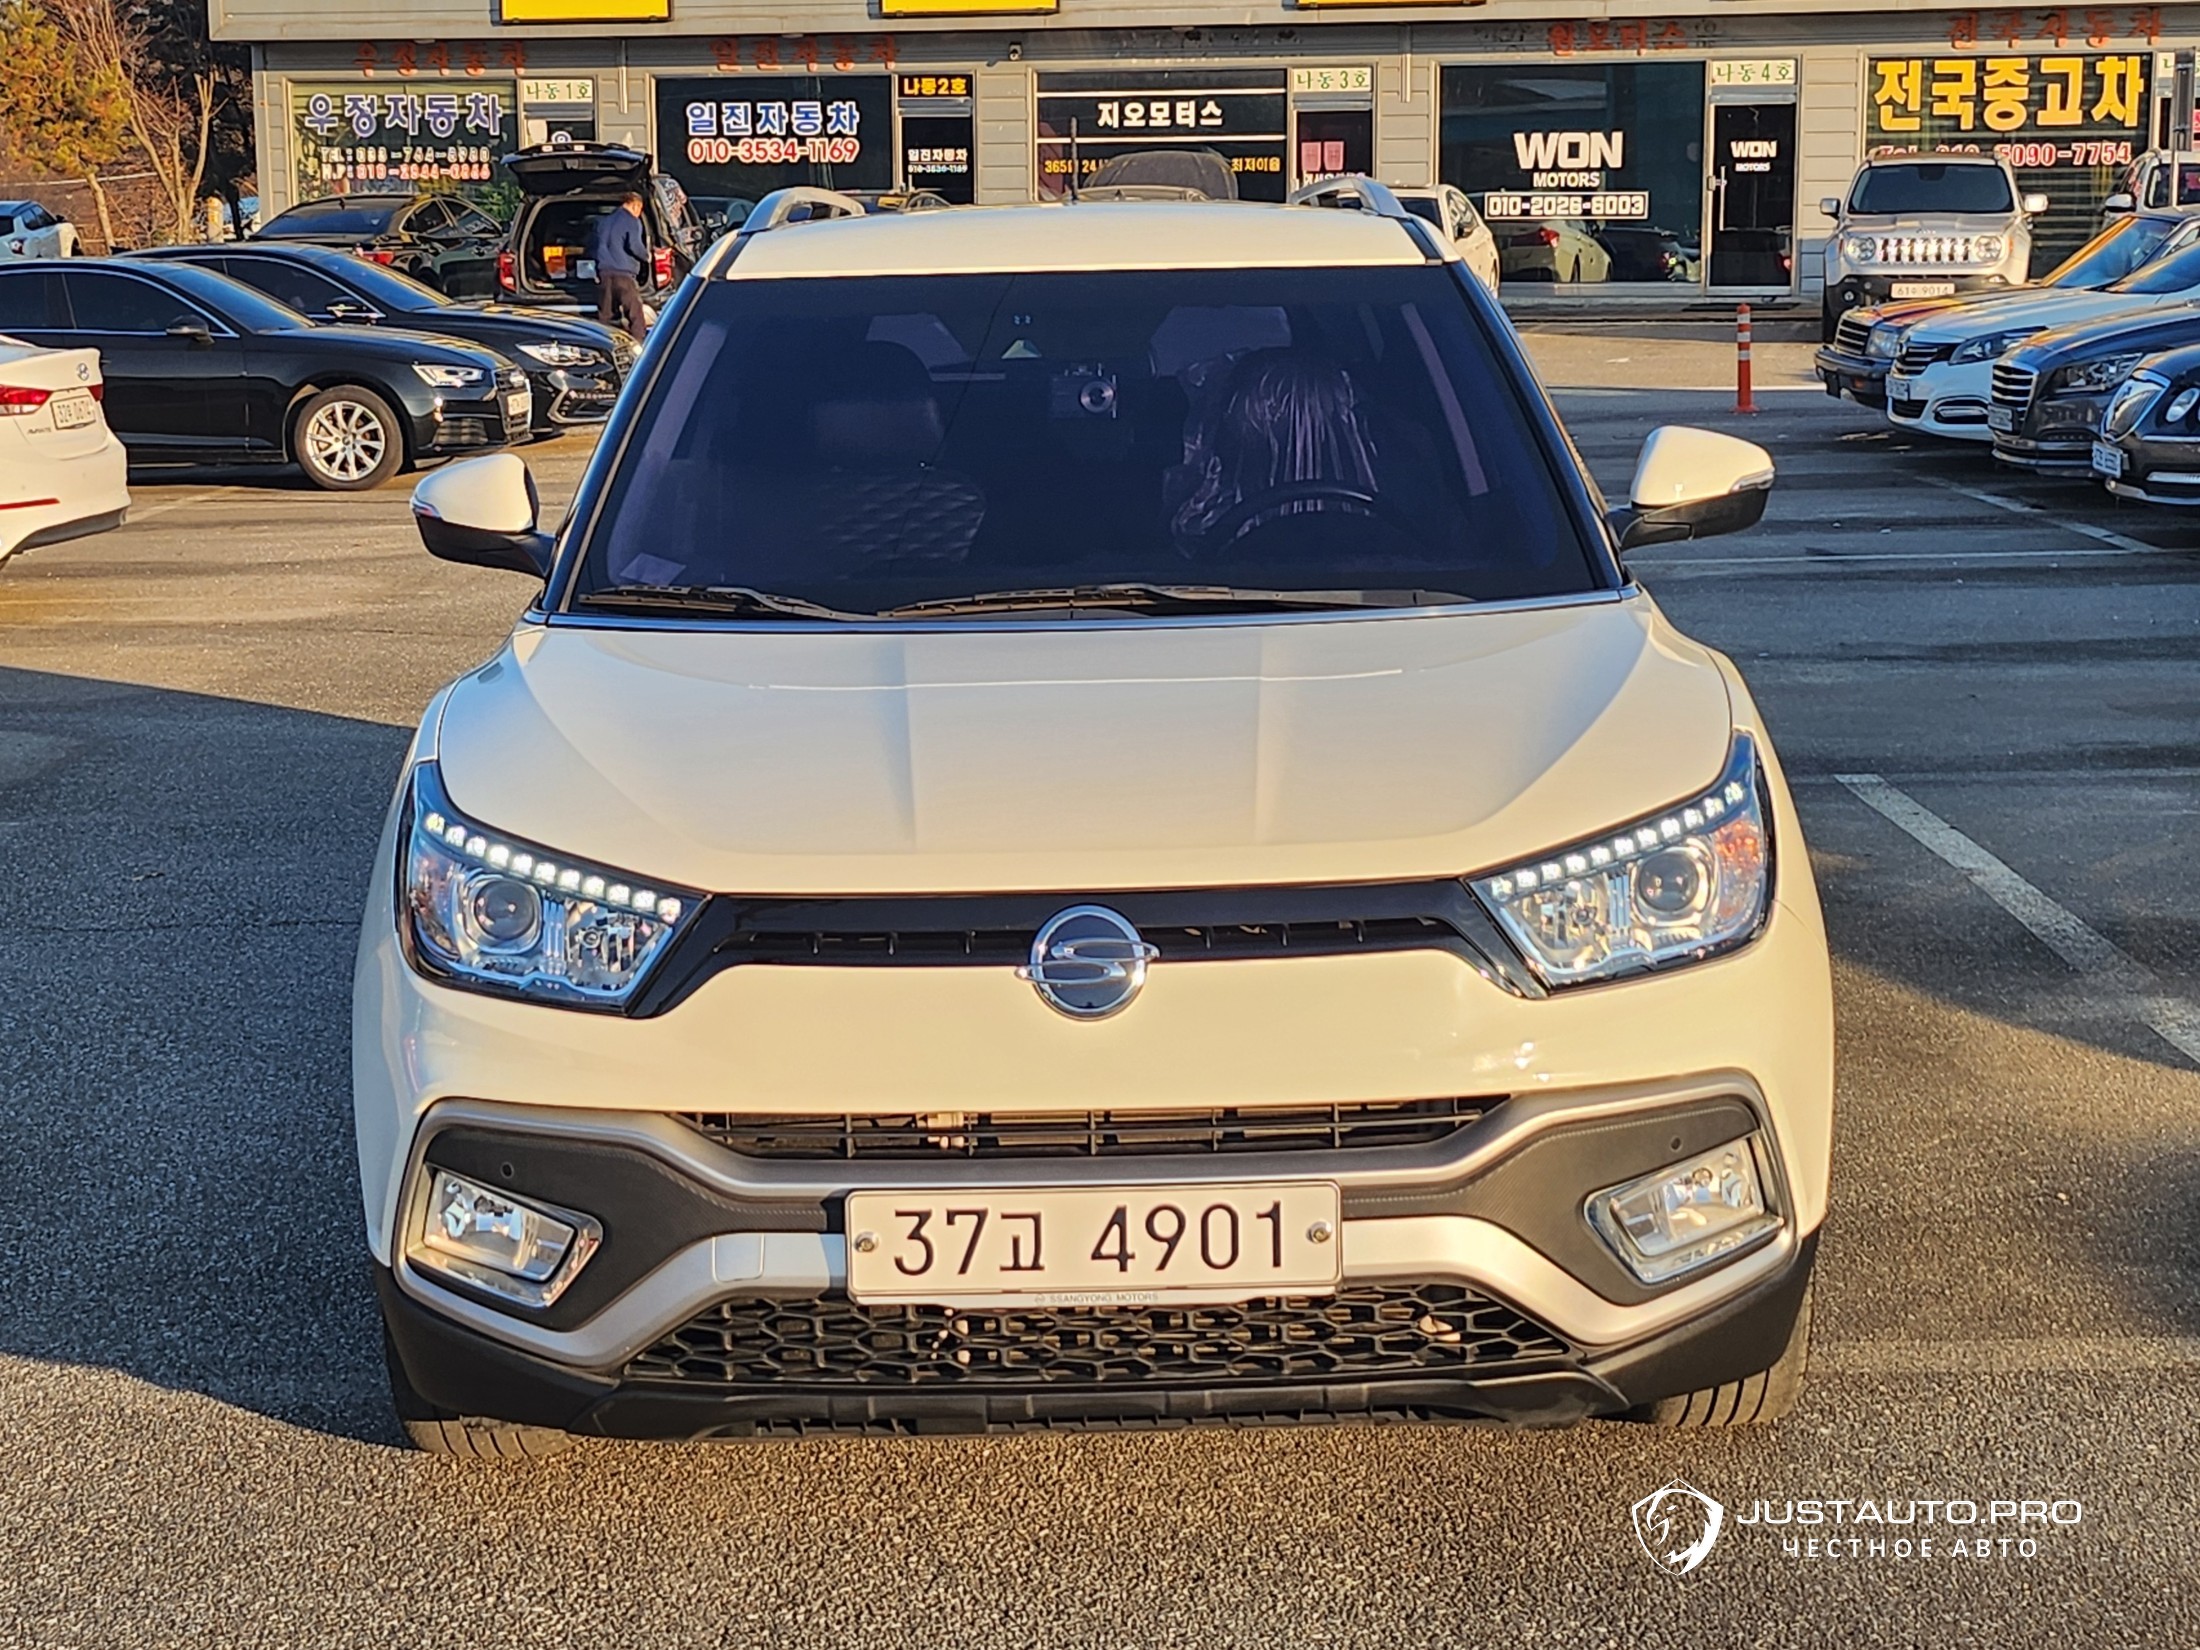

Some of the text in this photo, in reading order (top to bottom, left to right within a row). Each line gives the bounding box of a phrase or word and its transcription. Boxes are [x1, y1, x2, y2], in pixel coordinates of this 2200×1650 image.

[1296, 70, 1370, 89] 나동3호
[1716, 63, 1793, 82] 나동4호
[526, 82, 592, 100] 나동1호
[904, 78, 967, 95] 나동2호
[1874, 56, 2144, 131] 전국중고차
[304, 93, 501, 138] 우정자동차
[686, 101, 860, 136] 일진자동차
[1098, 100, 1223, 128] 지오모터스
[688, 137, 860, 163] 010-3534-1169
[1513, 130, 1624, 169] WON
[1730, 140, 1778, 157] WON
[1533, 172, 1600, 188] MOTORS
[893, 1200, 1282, 1276] 37고 4901
[1049, 1292, 1158, 1303] SSANGYONG MOTORS
